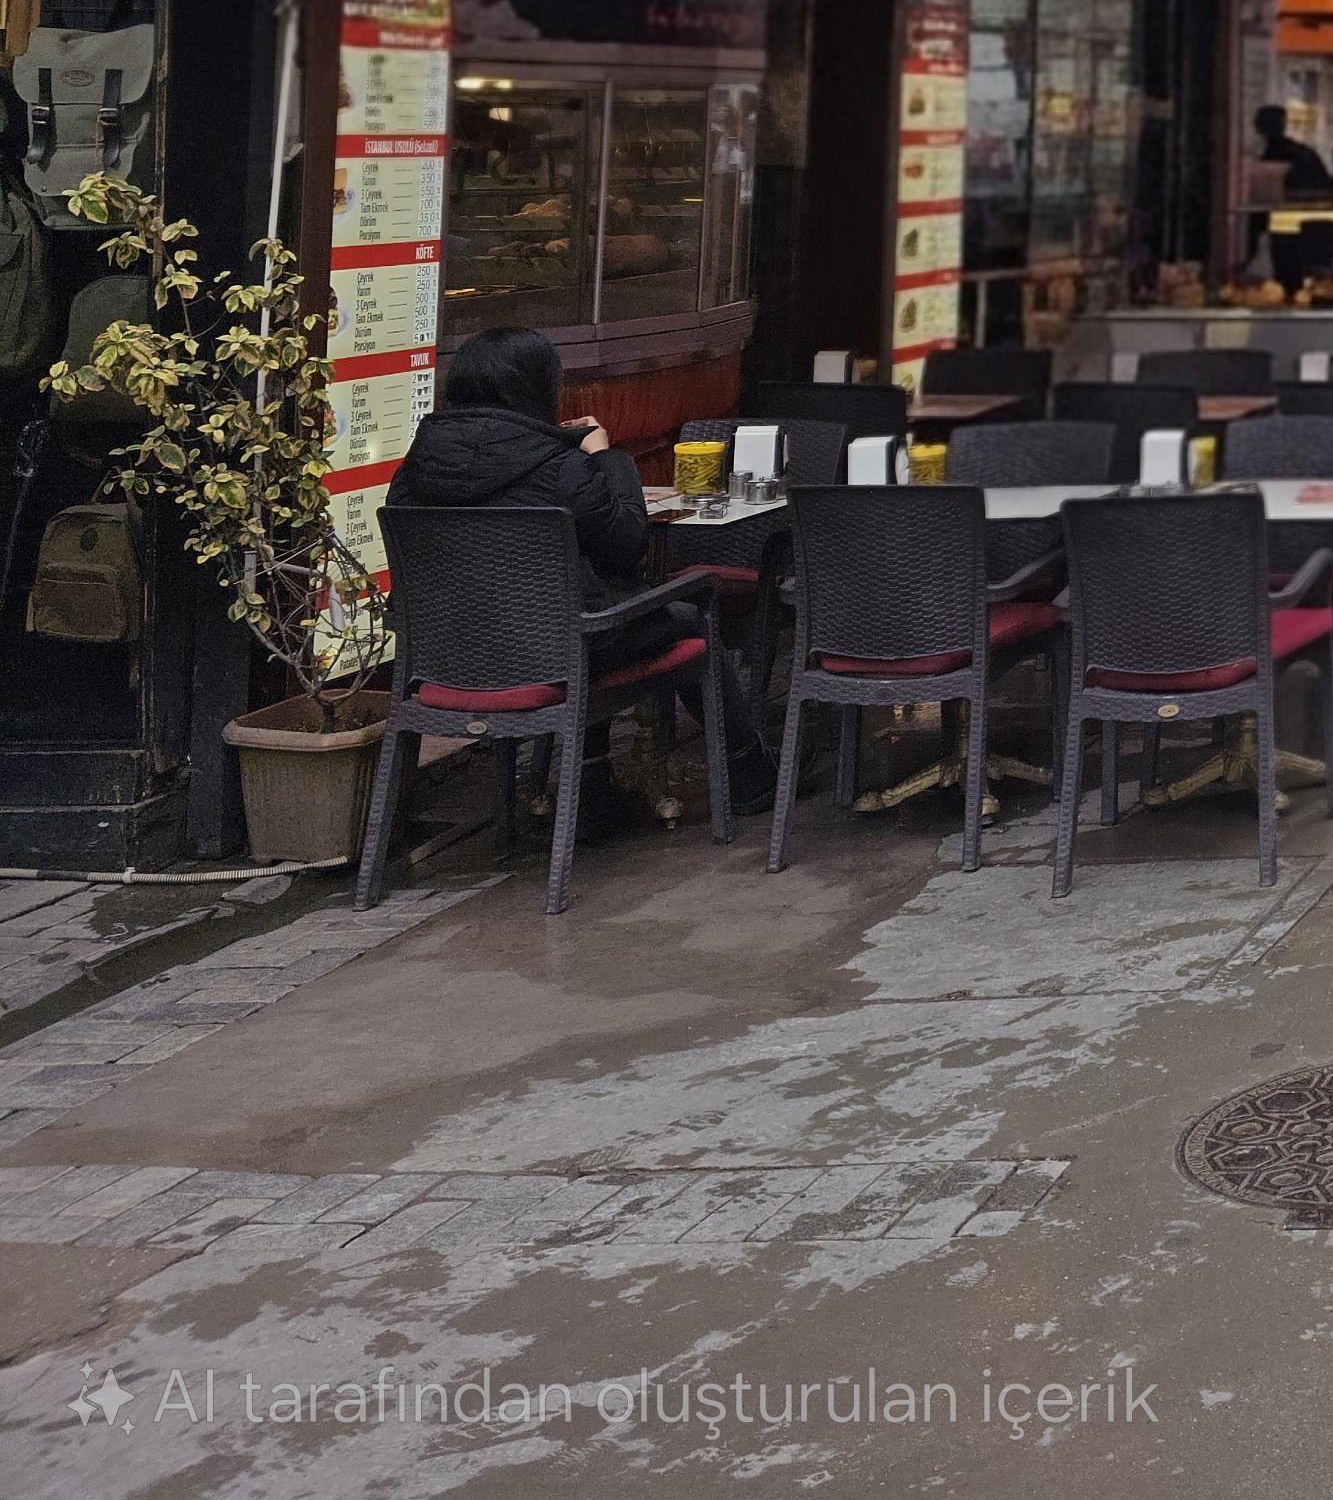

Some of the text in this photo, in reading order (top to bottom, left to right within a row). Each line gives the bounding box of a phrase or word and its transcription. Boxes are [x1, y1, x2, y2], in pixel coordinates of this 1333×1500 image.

[364, 138, 393, 153] İSTANBUL
[395, 138, 414, 153] USULÜ
[415, 244, 434, 260] KÖFTE
[357, 265, 431, 286] Çeyrek 250
[416, 279, 431, 291] 250
[360, 298, 377, 313] Çeyrek
[356, 313, 366, 324] Tam
[367, 311, 384, 323] Ekmek
[414, 318, 429, 331] 250
[410, 352, 430, 367] TAVUK
